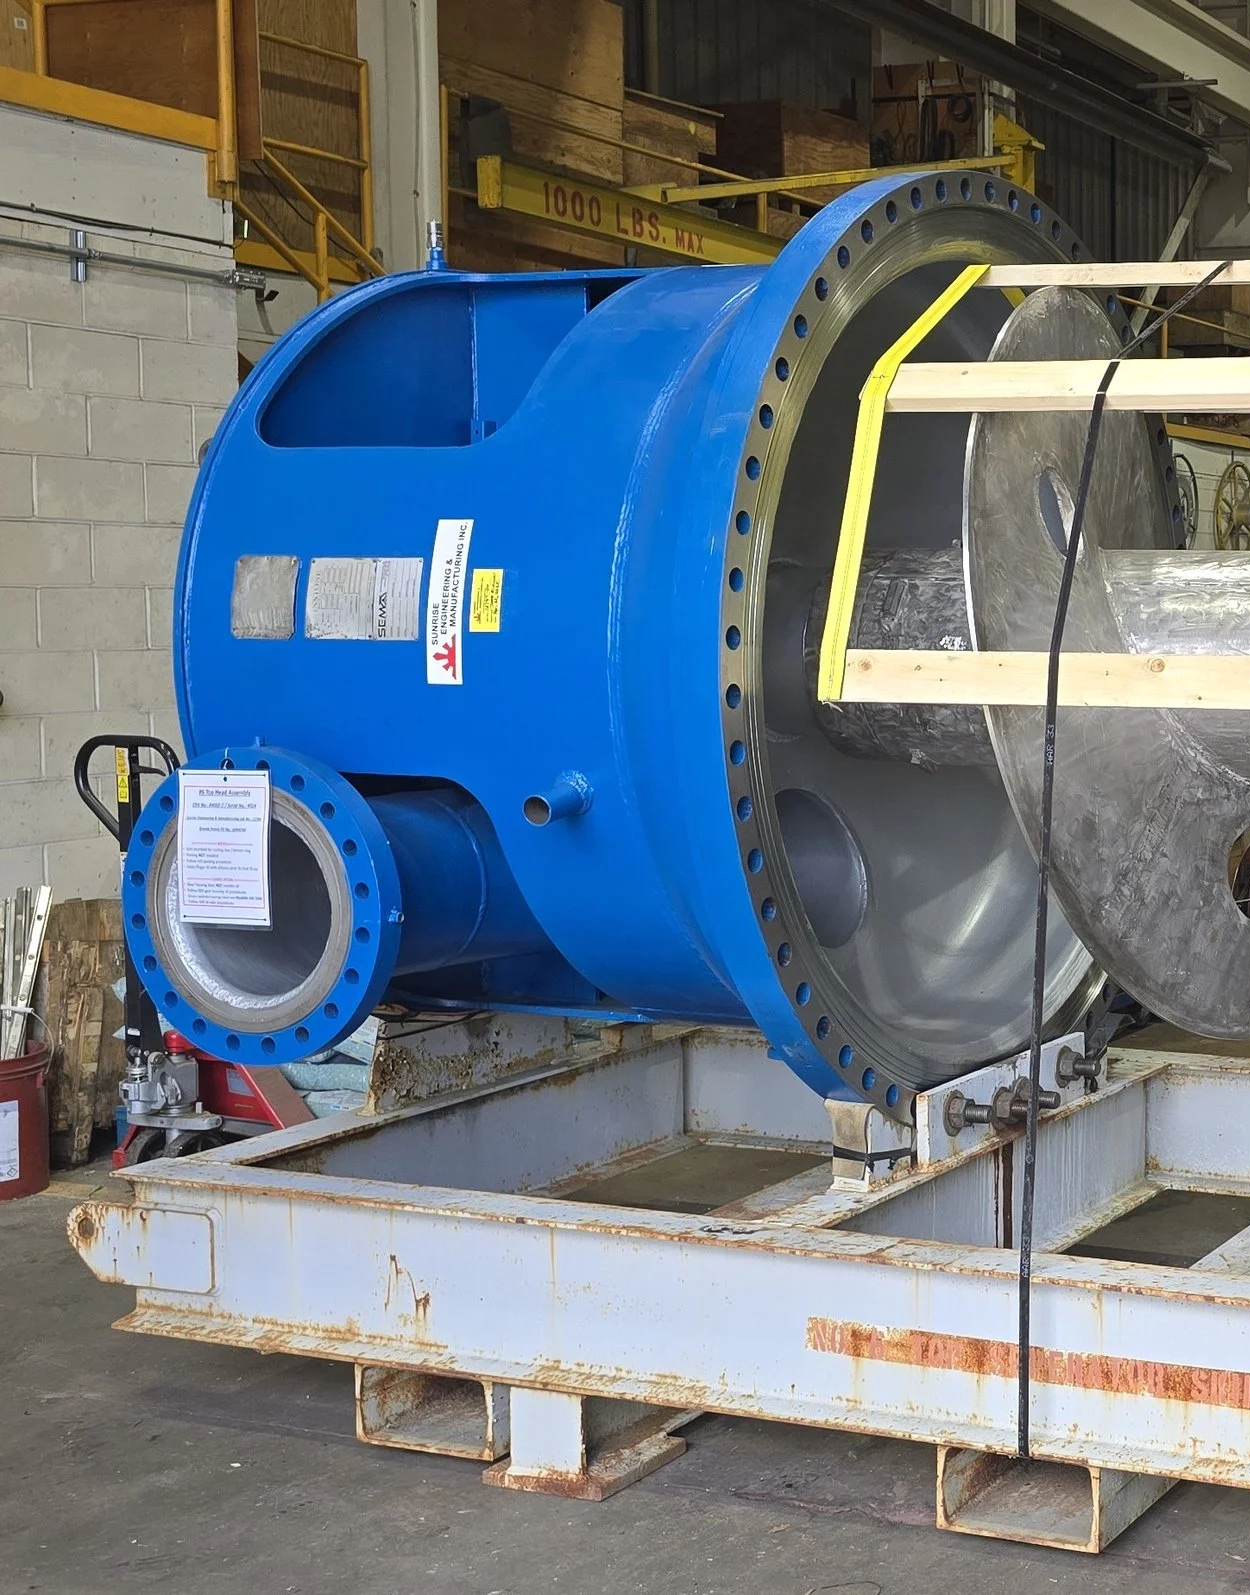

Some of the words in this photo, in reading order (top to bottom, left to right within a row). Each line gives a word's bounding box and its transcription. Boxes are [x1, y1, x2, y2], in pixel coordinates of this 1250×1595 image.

[543, 182, 602, 227] 1000
[616, 202, 667, 245] LBS.
[675, 228, 705, 255] MAX
[440, 567, 452, 635] ENGINEERING
[446, 558, 453, 566] &
[449, 543, 464, 628] MANUFACTURING
[458, 521, 469, 541] INC.
[431, 602, 440, 646] SUNRISE
